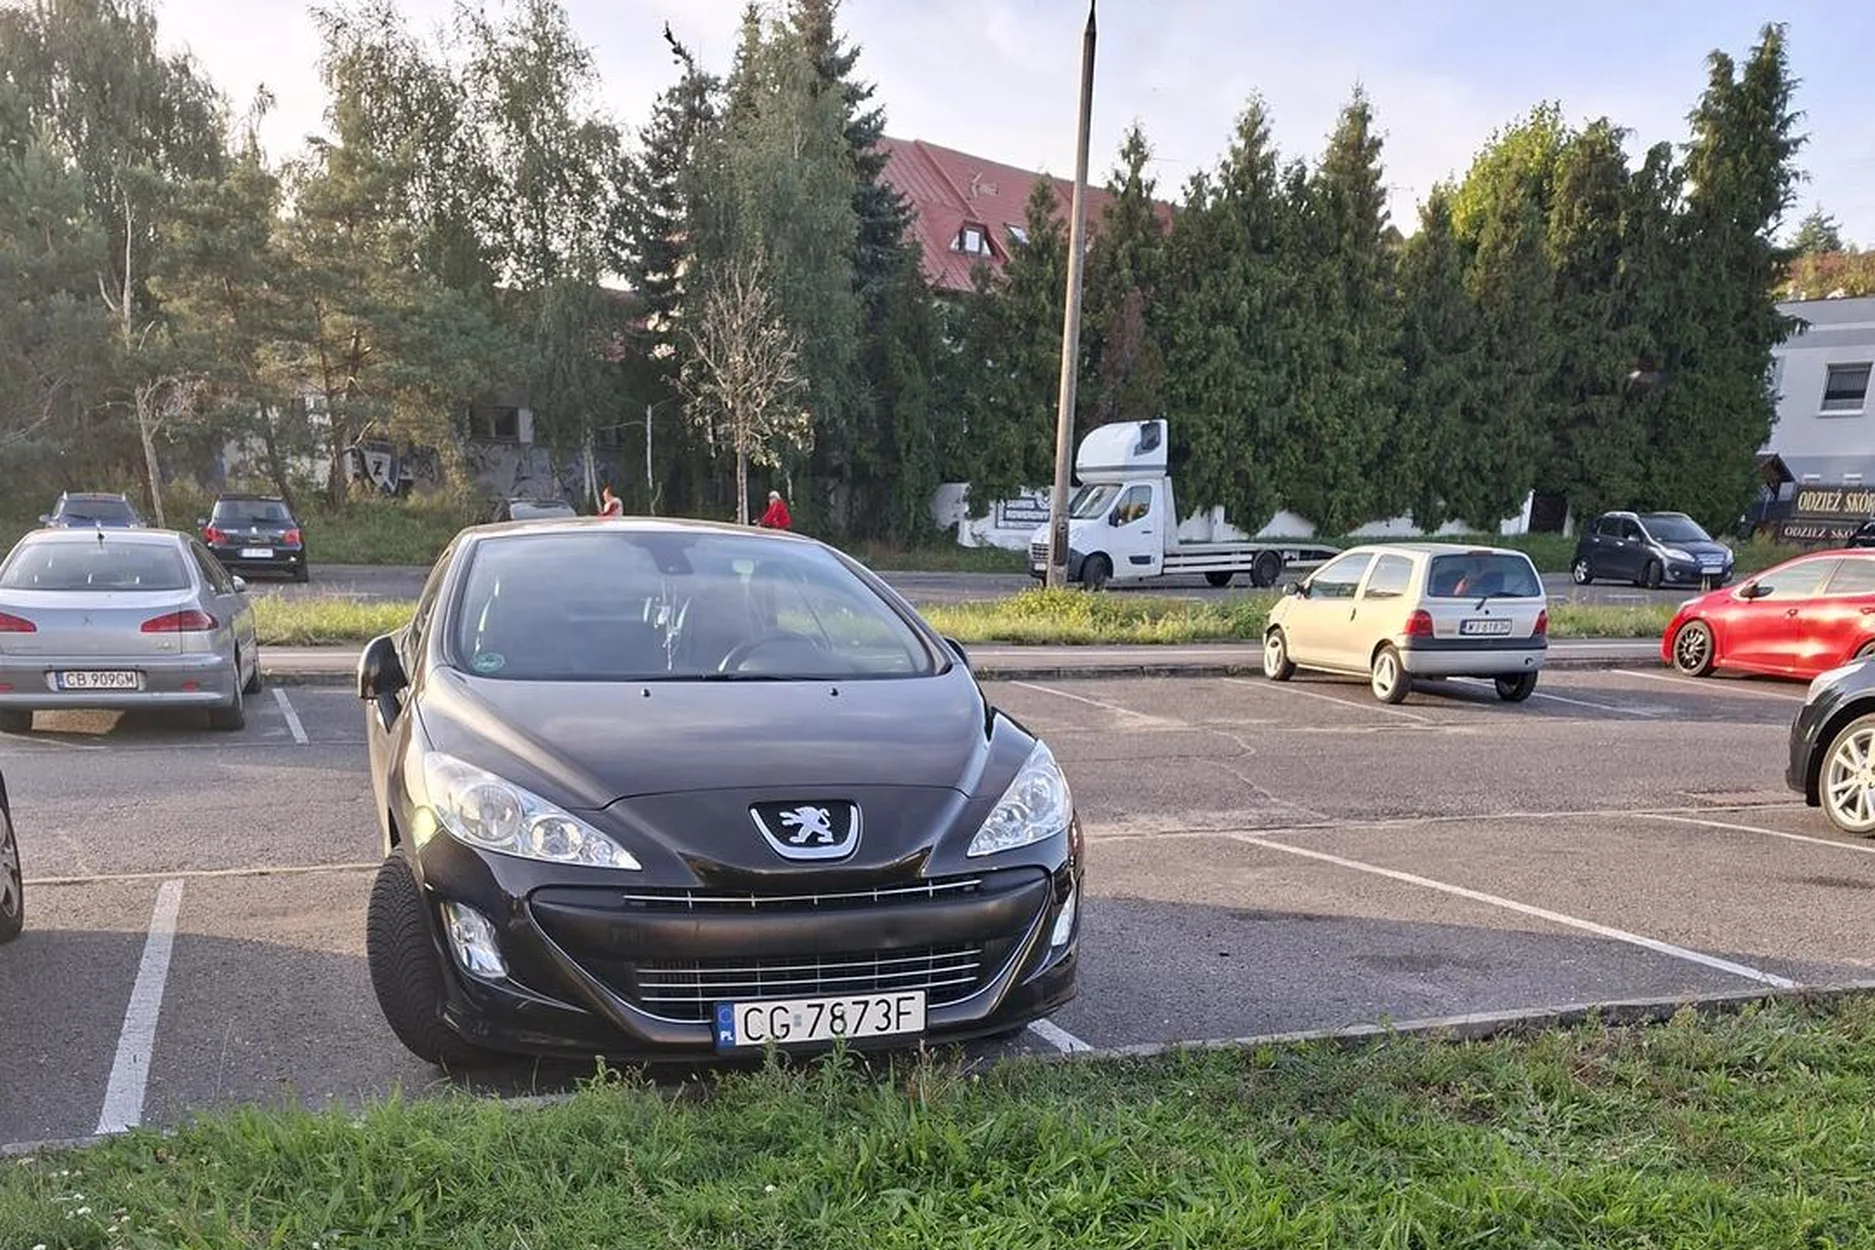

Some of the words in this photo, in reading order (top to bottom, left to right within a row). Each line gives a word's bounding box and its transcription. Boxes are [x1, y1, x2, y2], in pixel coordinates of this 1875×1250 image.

[1798, 489, 1842, 511] ODZIEŻ
[744, 1005, 790, 1041] CG
[806, 996, 915, 1037] 7873F
[720, 1030, 734, 1041] PL
